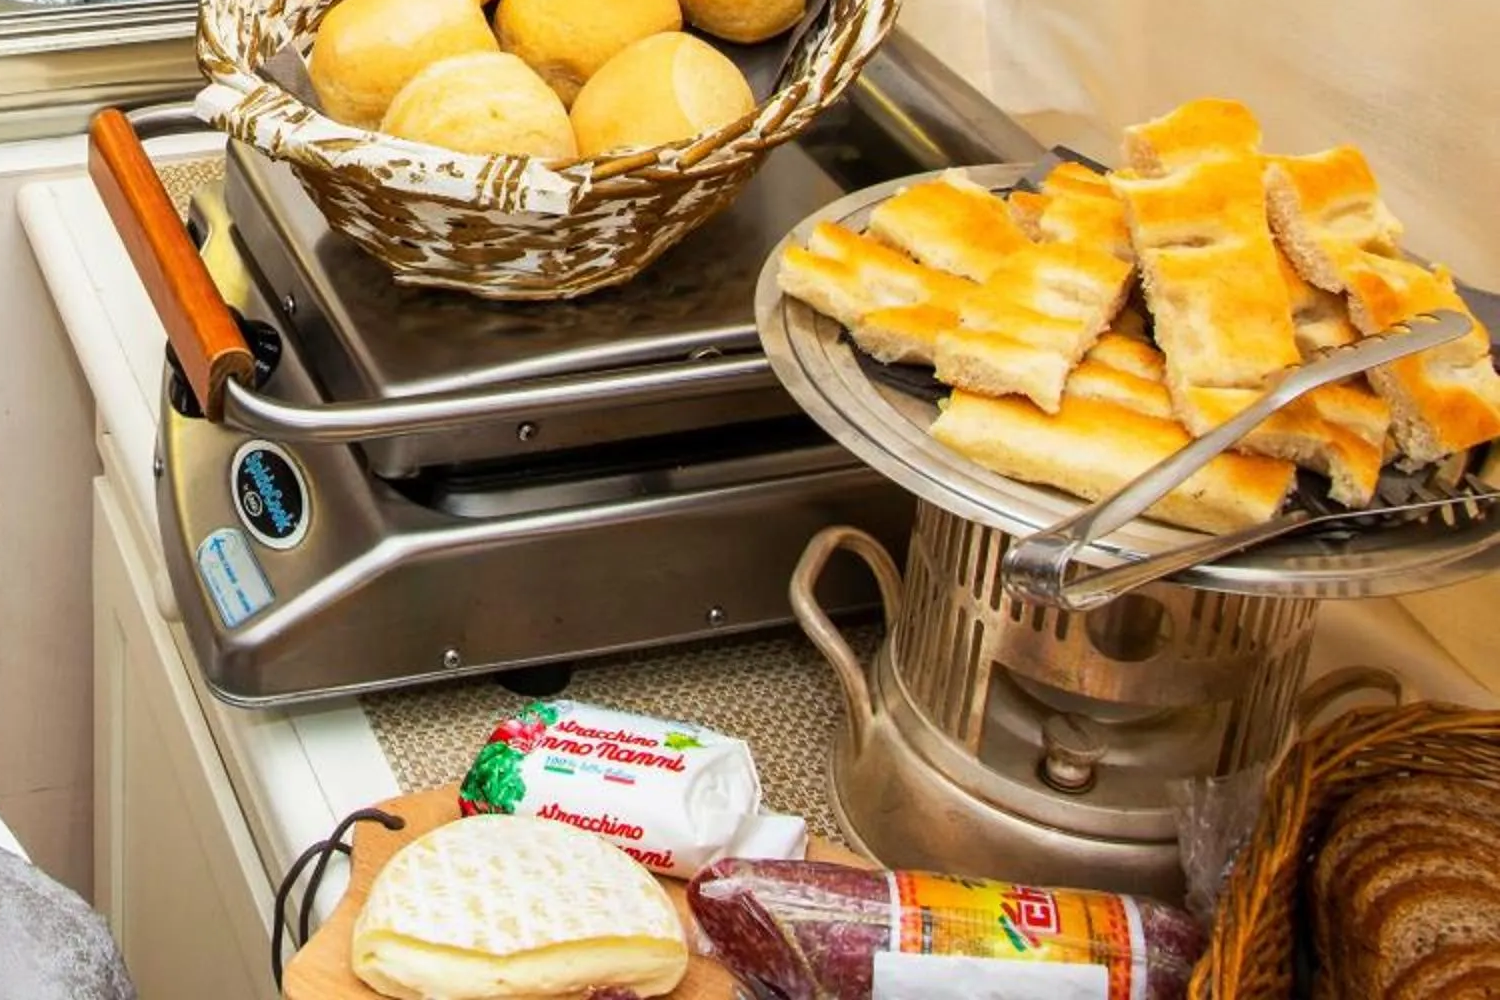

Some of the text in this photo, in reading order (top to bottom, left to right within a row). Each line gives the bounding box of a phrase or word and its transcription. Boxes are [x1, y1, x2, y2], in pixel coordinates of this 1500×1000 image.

[555, 719, 660, 748] stracchino
[596, 741, 687, 773] Nanni
[535, 802, 644, 841] stracchino
